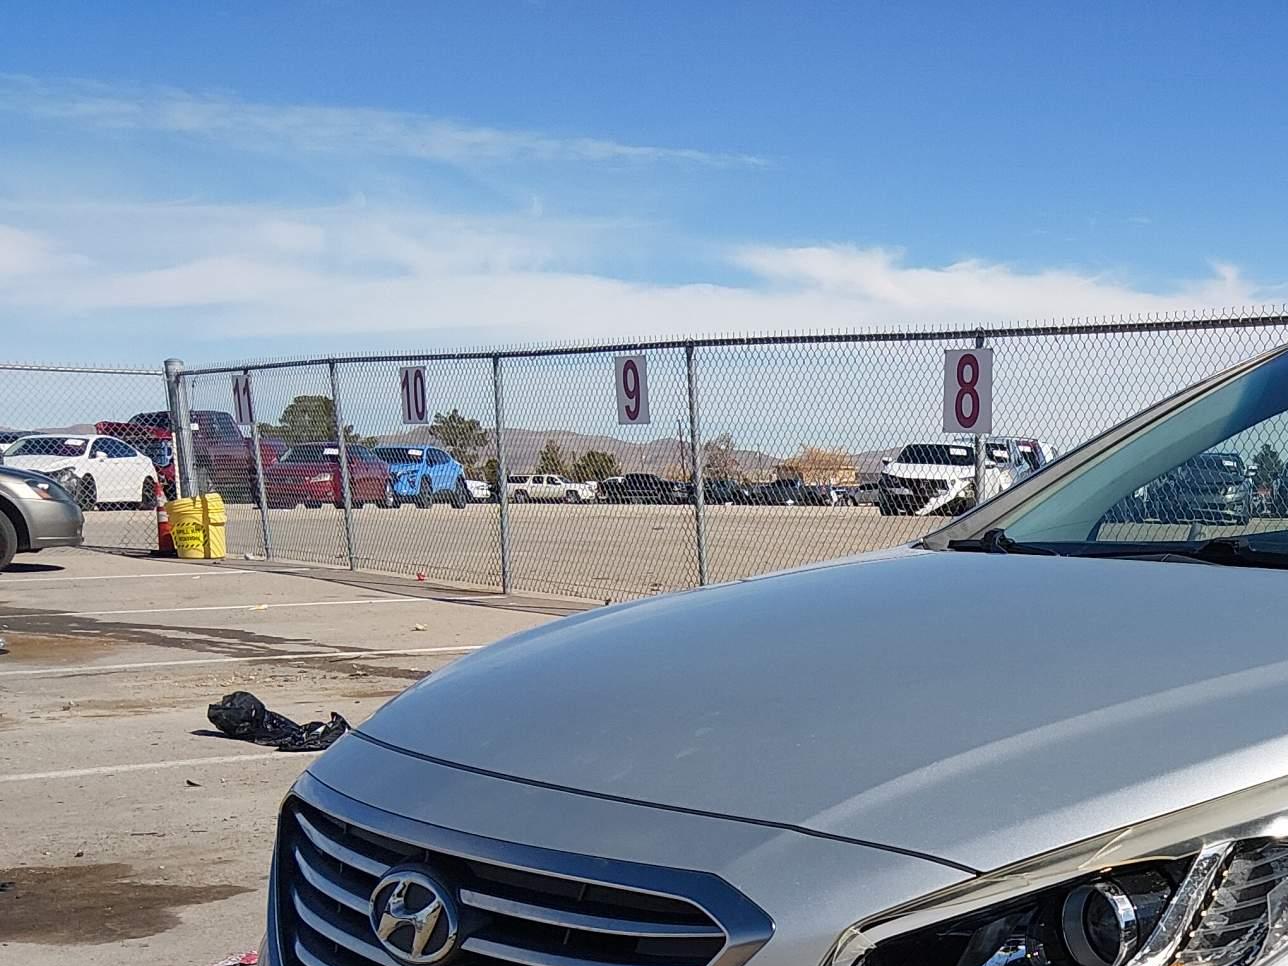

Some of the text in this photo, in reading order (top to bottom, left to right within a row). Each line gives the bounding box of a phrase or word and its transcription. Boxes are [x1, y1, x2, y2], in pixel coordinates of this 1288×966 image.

[233, 377, 253, 422] 11
[402, 369, 425, 421] 10
[622, 359, 641, 421] 9
[955, 353, 980, 429] 8
